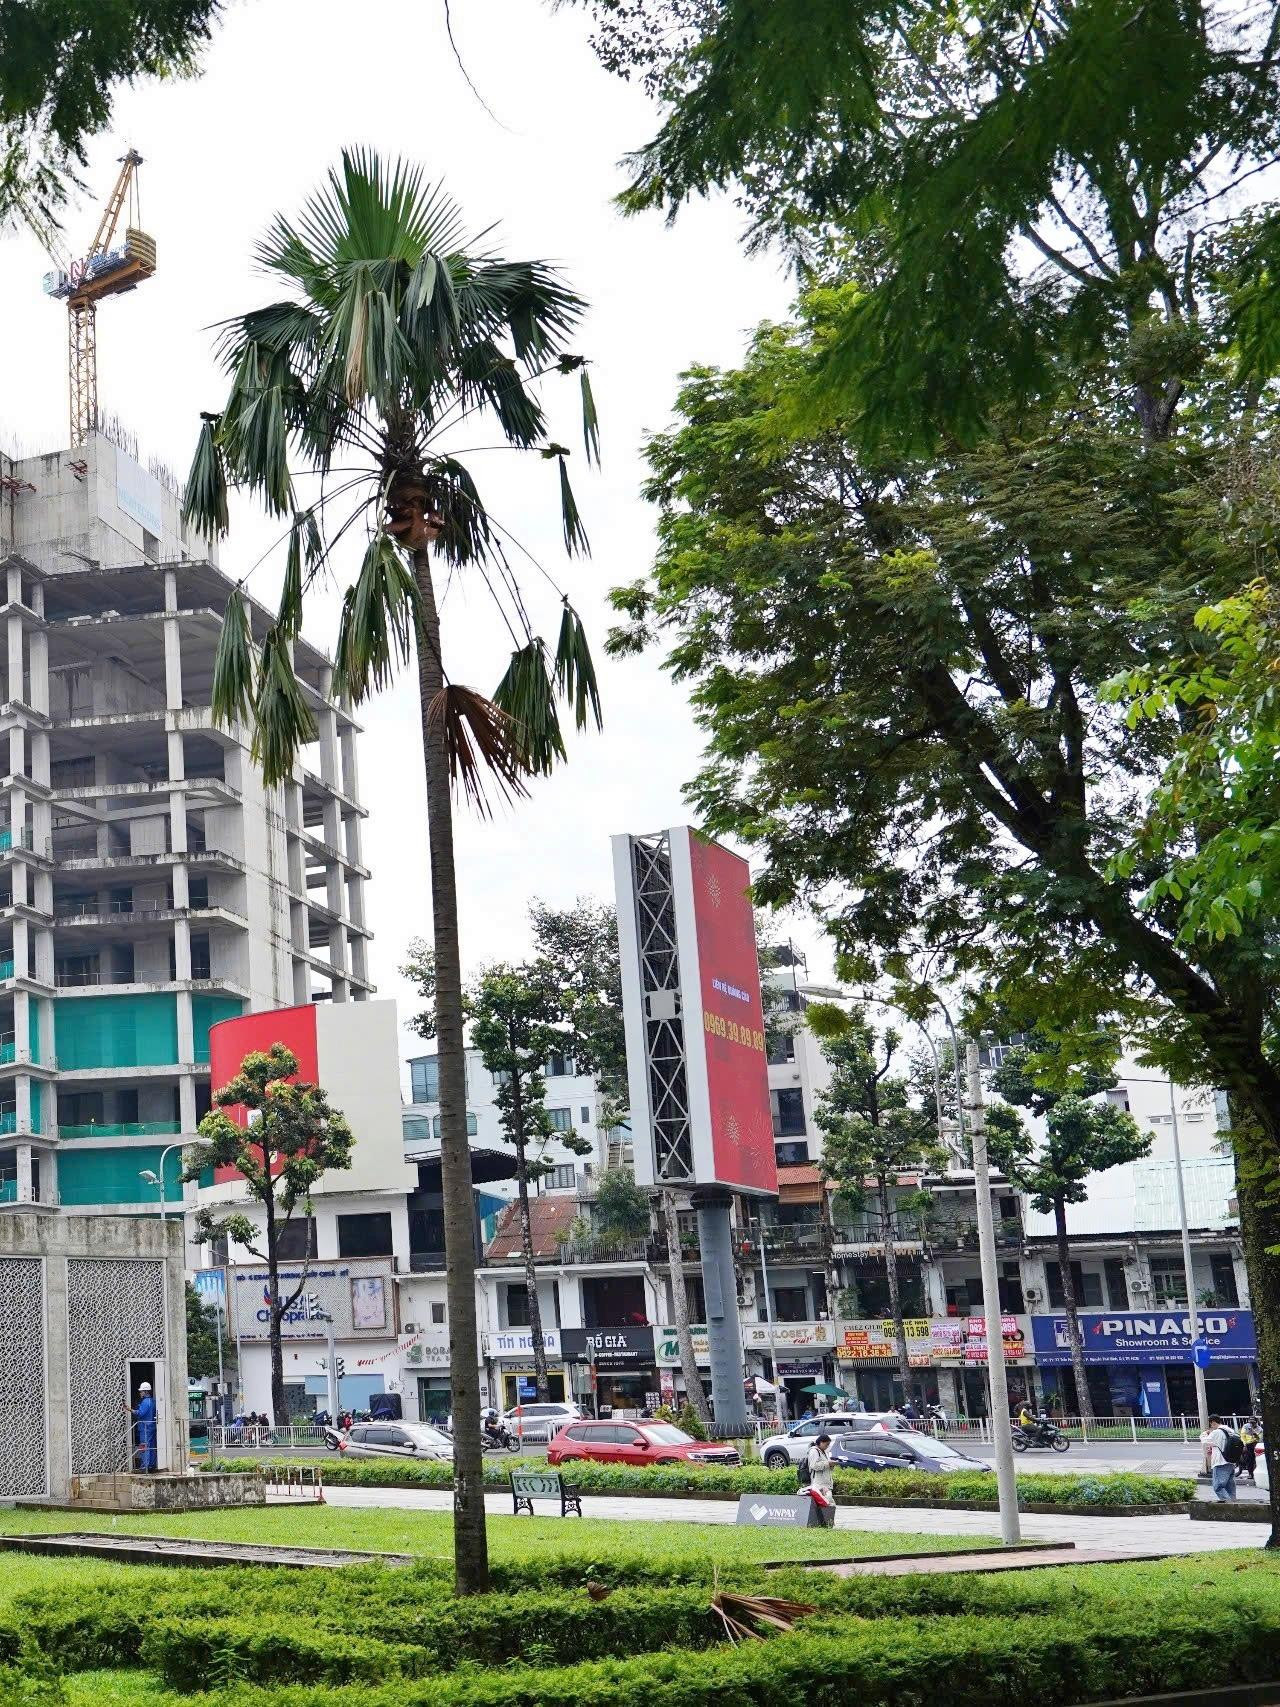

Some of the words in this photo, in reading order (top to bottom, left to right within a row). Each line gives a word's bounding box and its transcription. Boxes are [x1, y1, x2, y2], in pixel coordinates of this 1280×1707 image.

[1103, 1317, 1228, 1336] PINACO
[1116, 1338, 1169, 1347] Showroom
[1182, 1337, 1220, 1346] Seice
[769, 1508, 798, 1517] VNPAY
